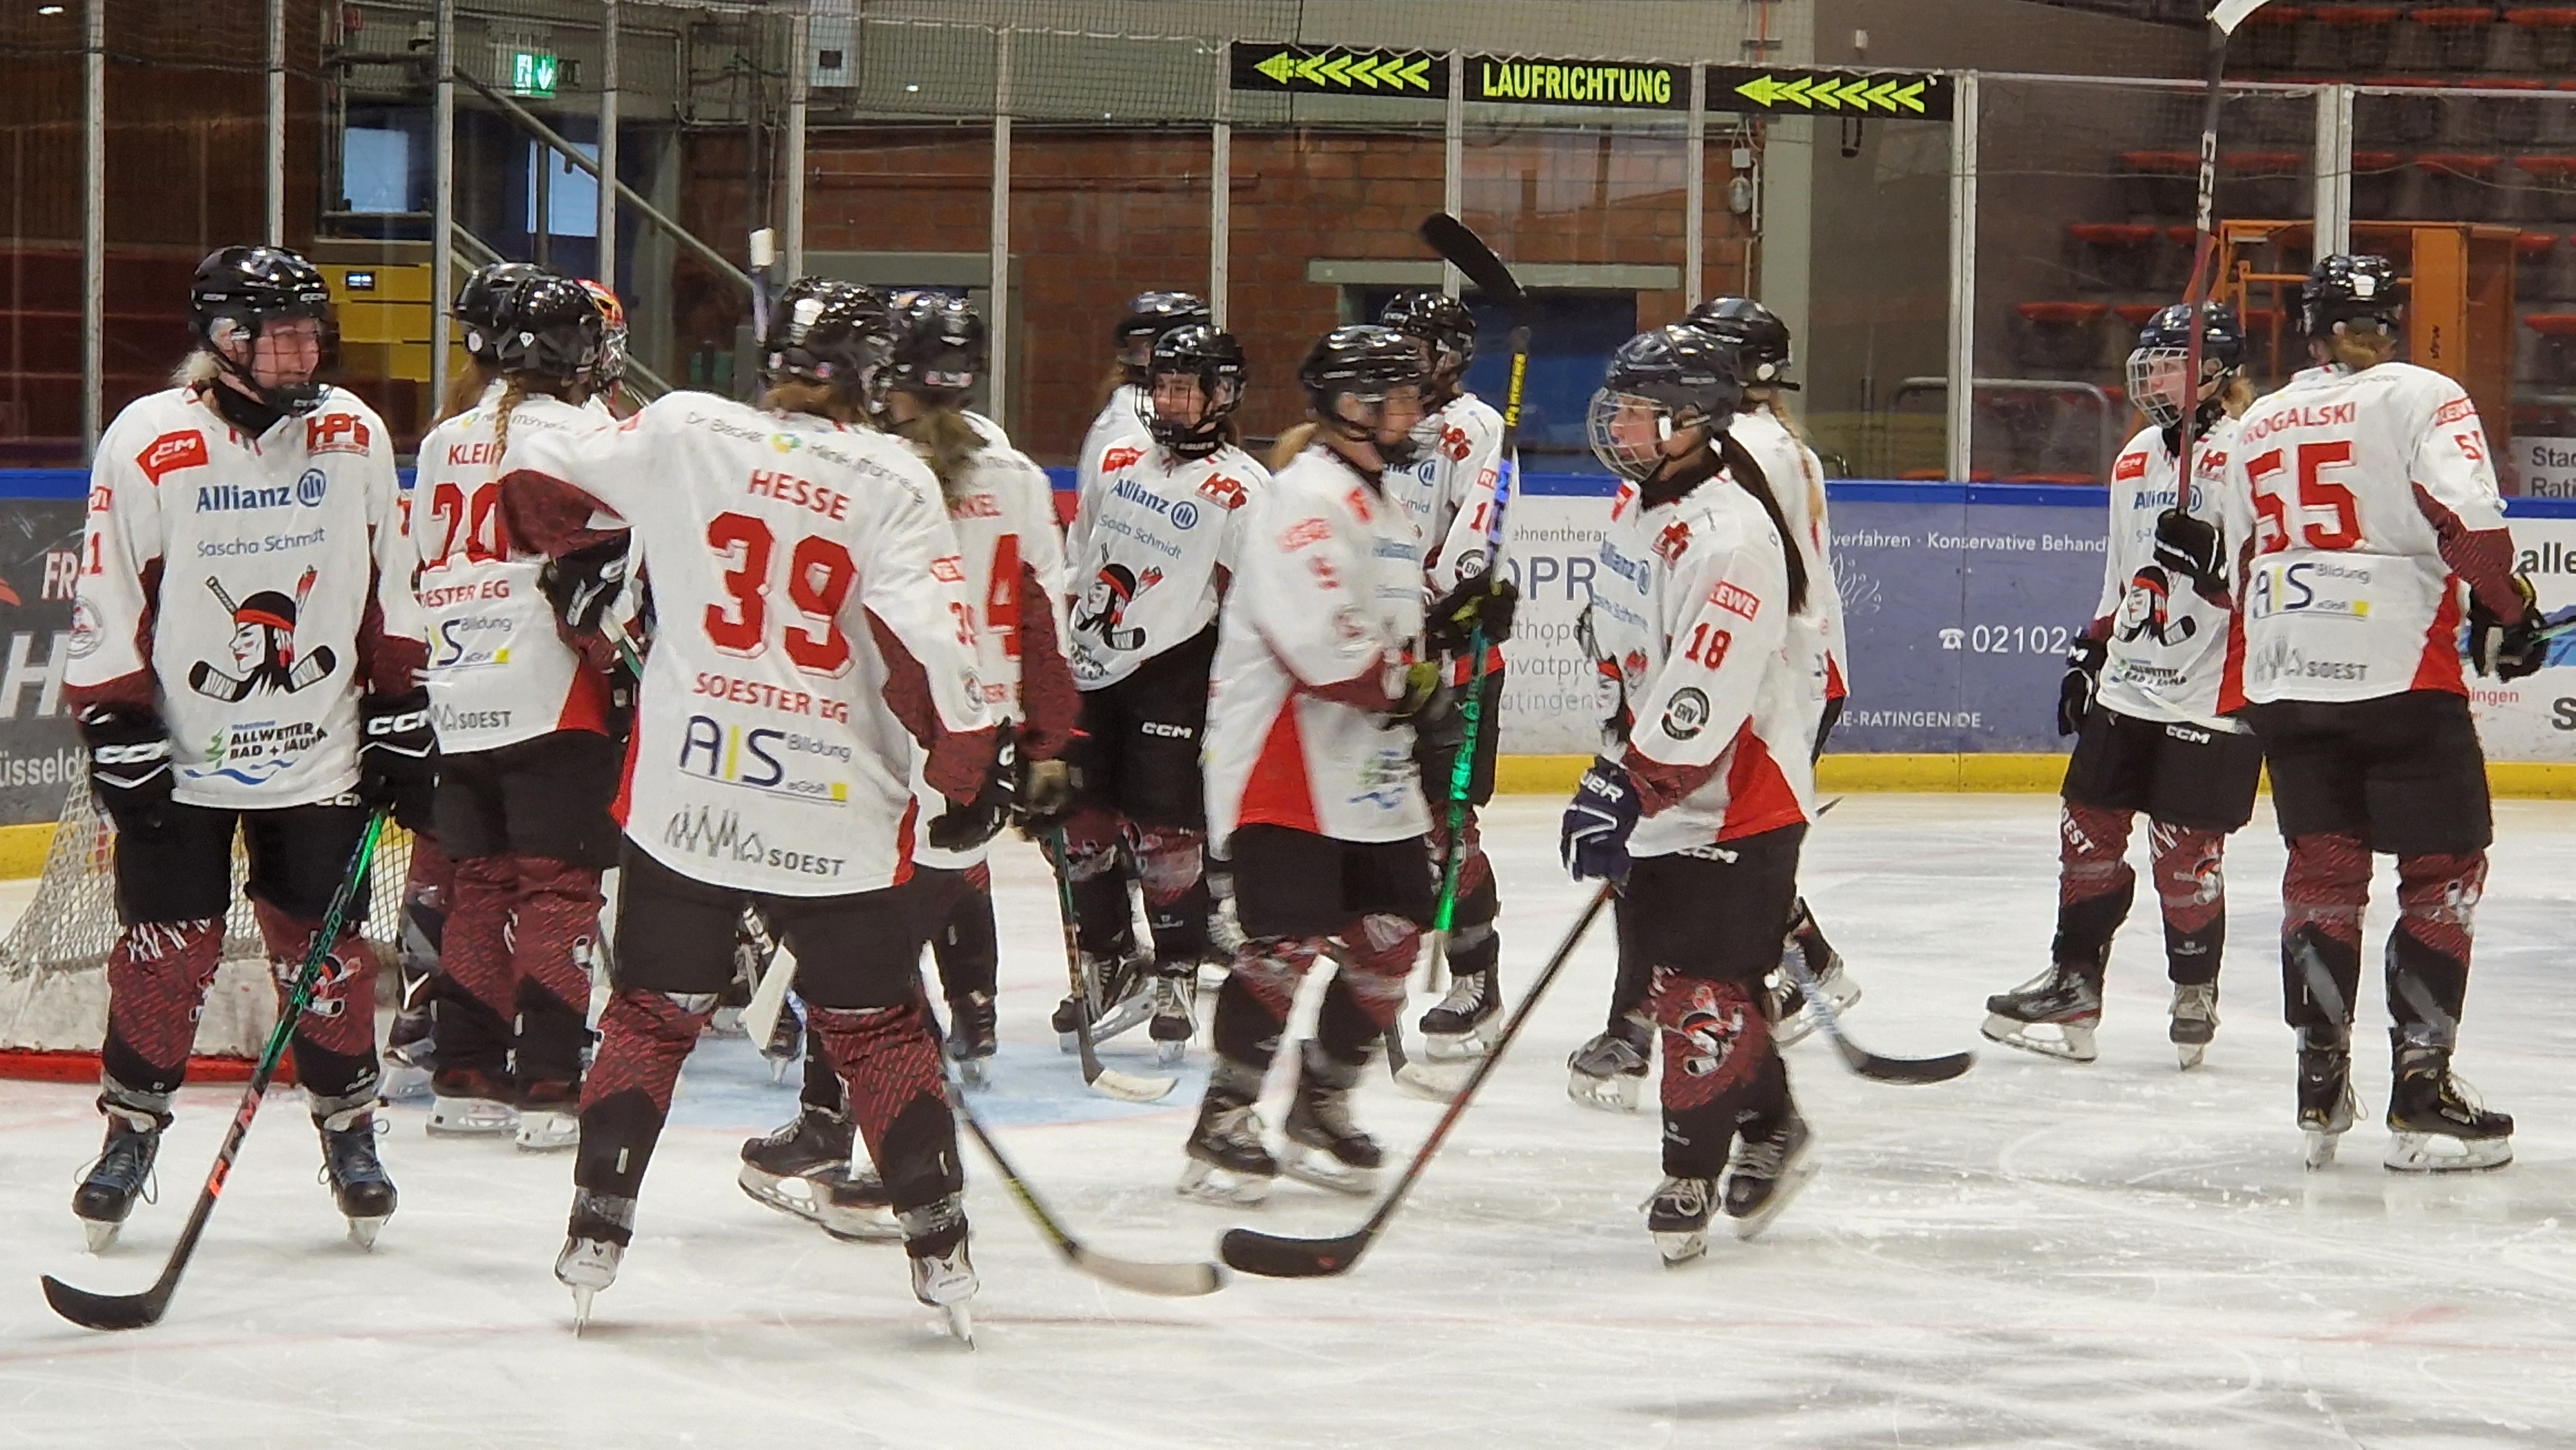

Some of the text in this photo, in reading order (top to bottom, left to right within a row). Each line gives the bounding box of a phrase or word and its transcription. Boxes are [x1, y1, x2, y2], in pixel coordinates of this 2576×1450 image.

[1483, 62, 1671, 103] LAUFRICHTUNG
[195, 485, 291, 513] Allianz
[748, 469, 851, 522] HESSE
[1110, 478, 1170, 514] Allianz
[2245, 440, 2361, 554] 55
[1927, 532, 2036, 552] Konservative
[419, 579, 509, 607] ESTER EG
[704, 511, 858, 678] 39
[1685, 622, 1732, 671] 18
[1973, 625, 2067, 654] 02102
[692, 672, 849, 724] SOESTER EG
[230, 722, 314, 746] ALLWETTER
[459, 710, 513, 729] SOEST
[1142, 721, 1193, 739] CCM
[2166, 725, 2211, 745] CCM
[679, 714, 786, 787] AIS
[768, 848, 846, 877] SOEST
